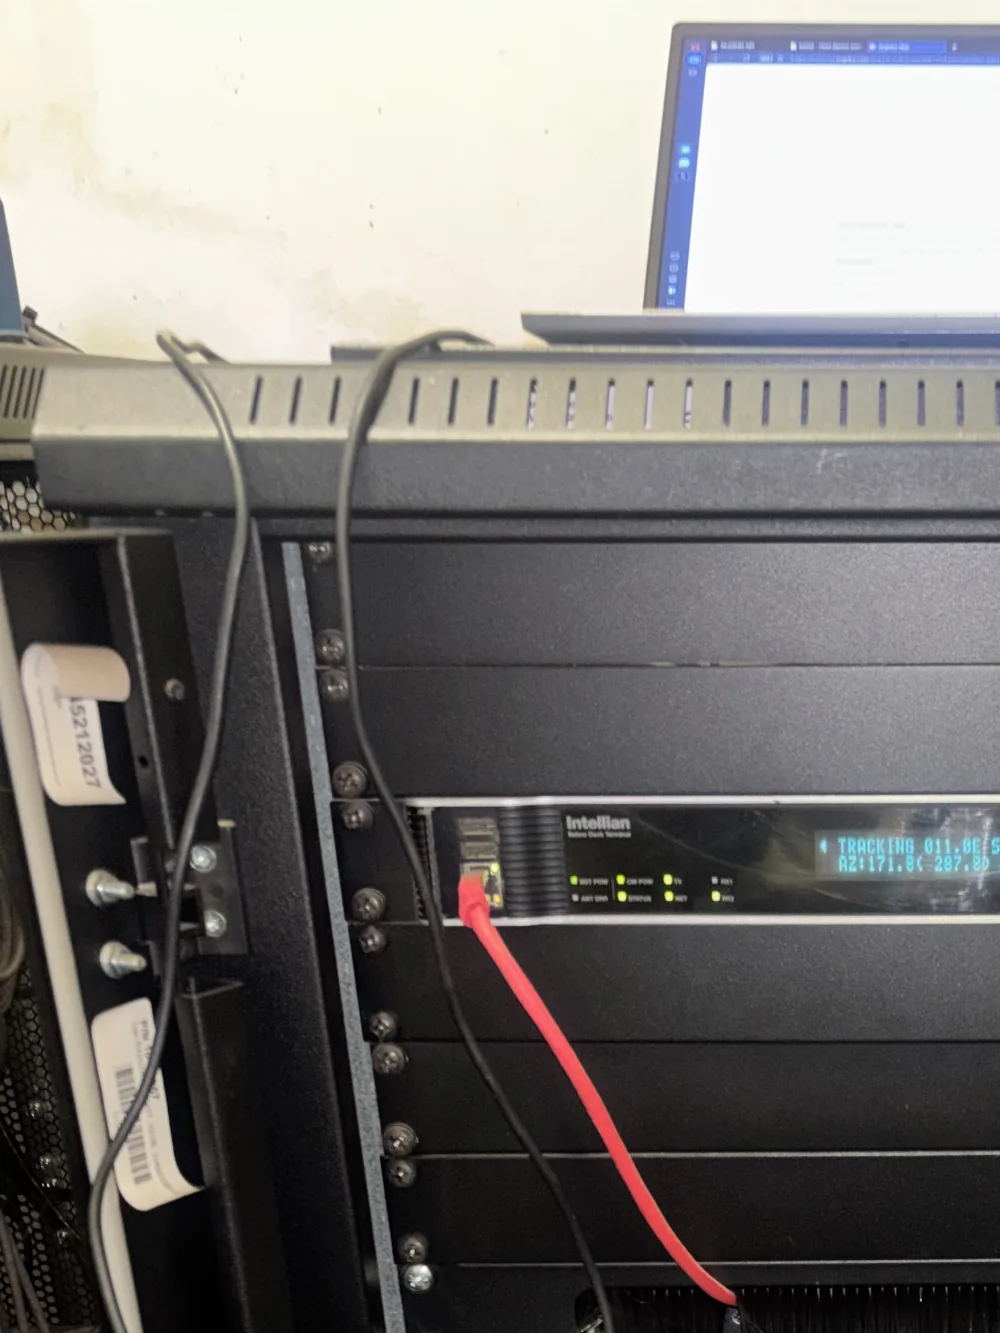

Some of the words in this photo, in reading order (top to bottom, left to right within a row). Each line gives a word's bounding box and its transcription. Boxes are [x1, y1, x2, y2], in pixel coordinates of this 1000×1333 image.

[565, 814, 631, 831] Intellian
[837, 836, 915, 854] TRACKING
[924, 836, 982, 854] 011.0E
